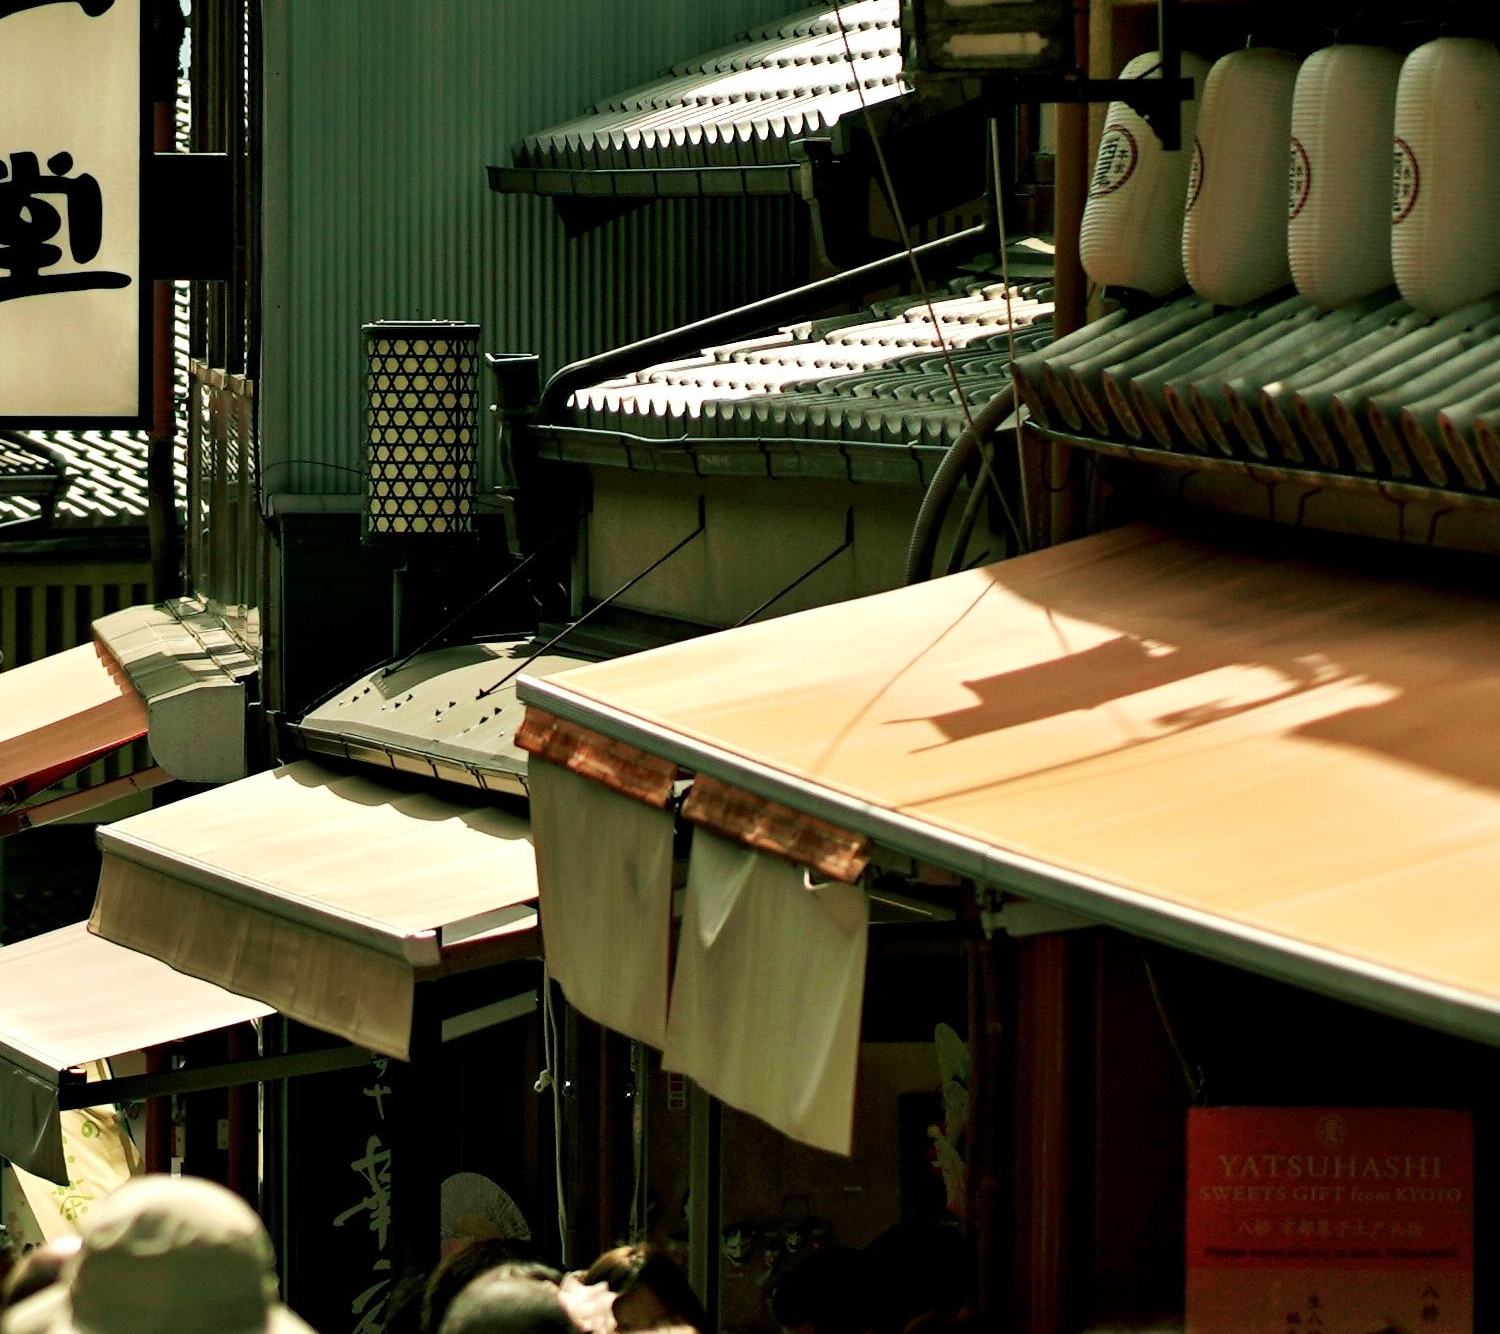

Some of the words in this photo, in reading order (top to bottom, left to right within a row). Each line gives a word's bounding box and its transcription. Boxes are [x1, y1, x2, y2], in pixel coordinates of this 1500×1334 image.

[1218, 1154, 1442, 1180] YATSUHASHI
[1199, 1186, 1286, 1203] SWEETS
[1292, 1186, 1345, 1203] GIFT
[1351, 1186, 1390, 1203] from
[1395, 1186, 1462, 1203] KYOTO
